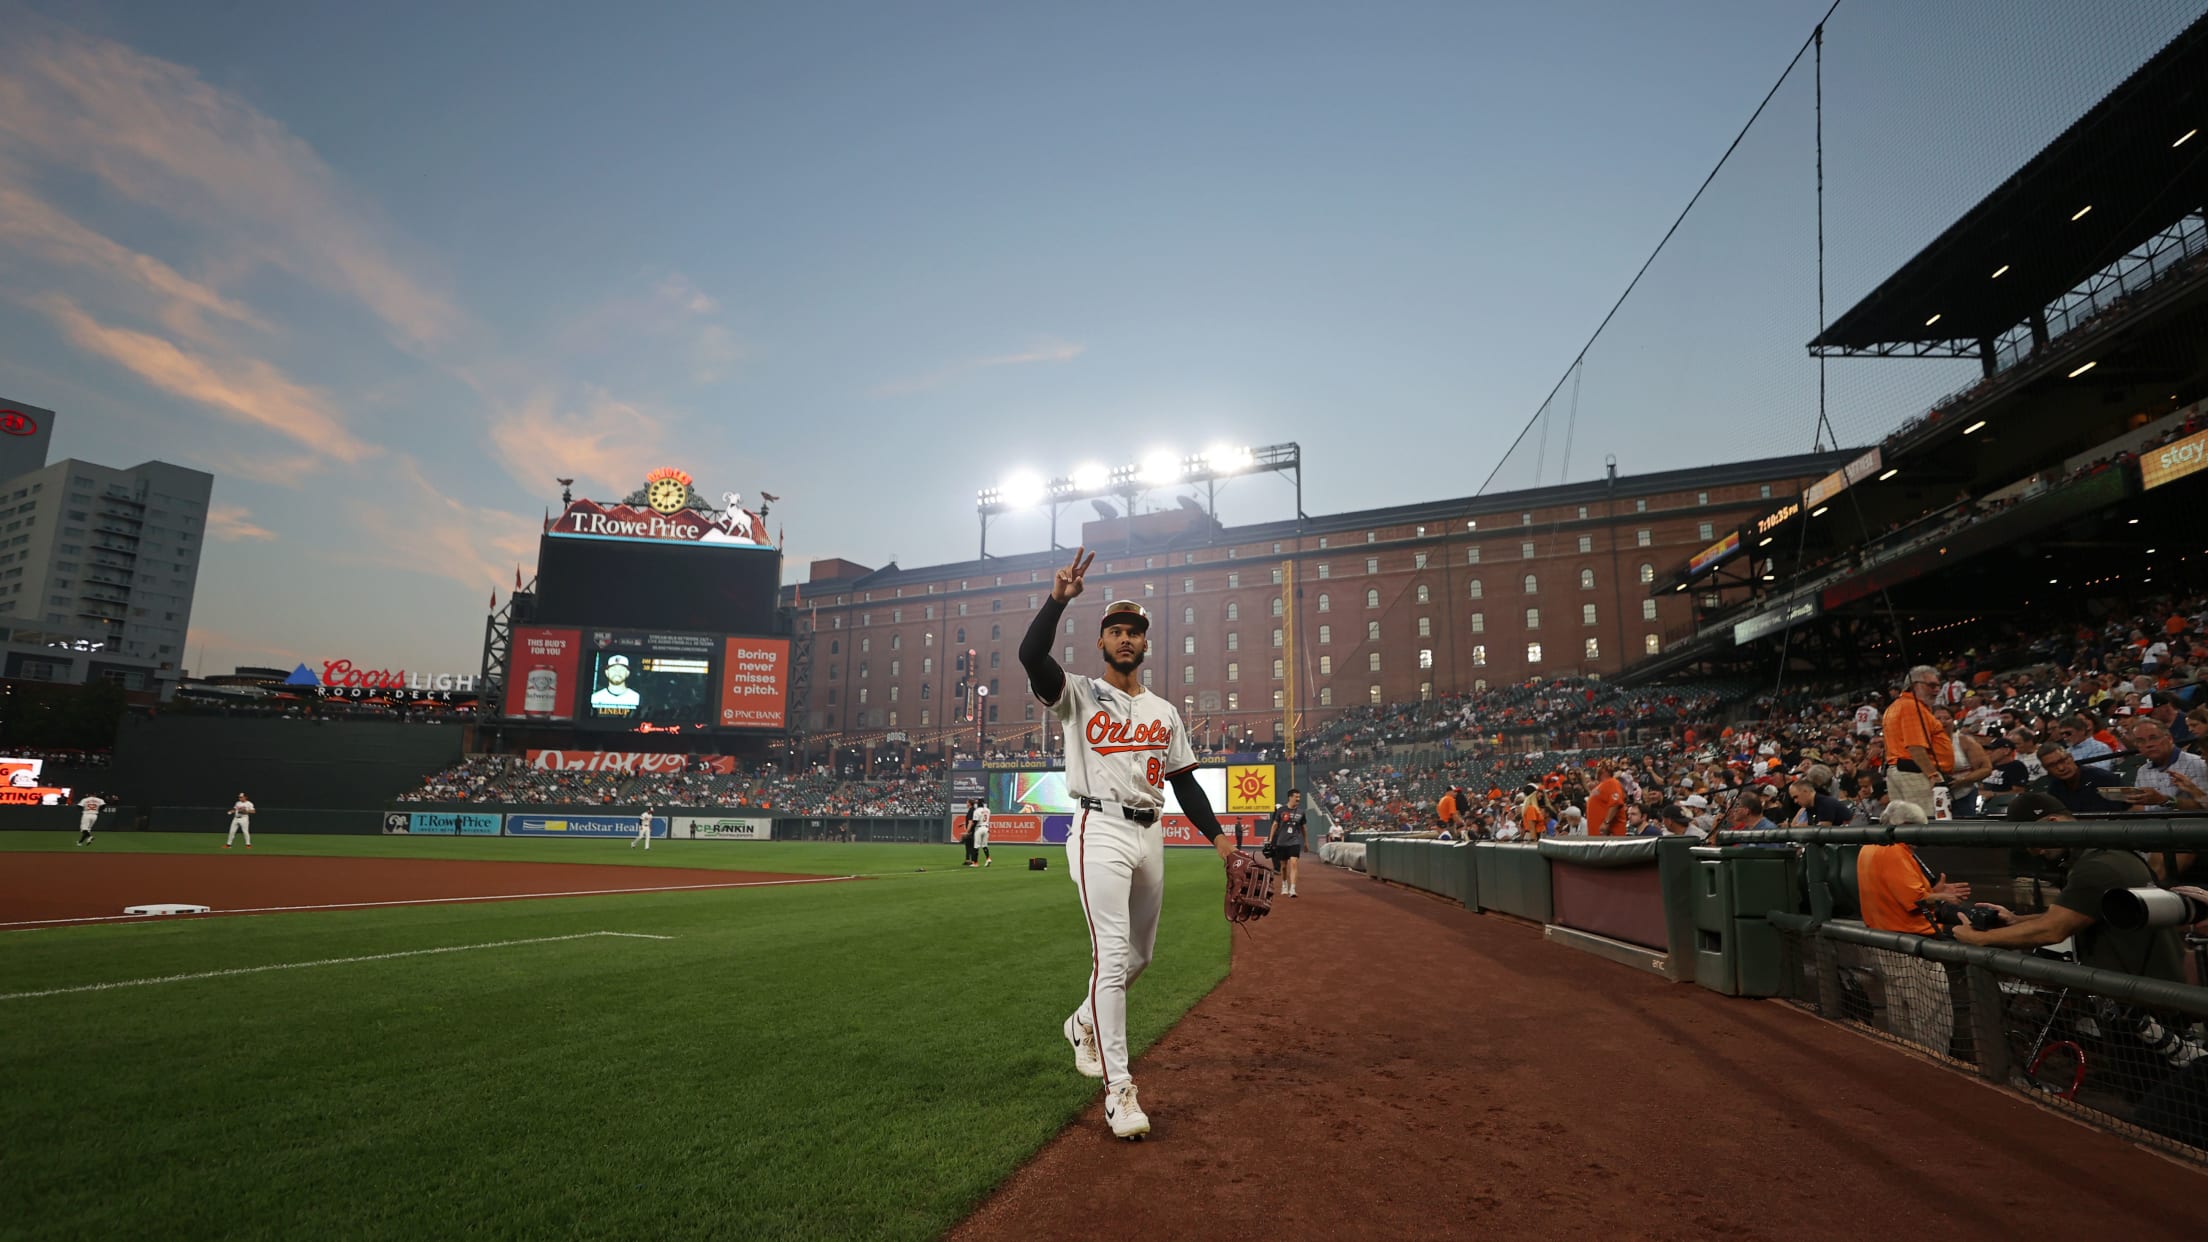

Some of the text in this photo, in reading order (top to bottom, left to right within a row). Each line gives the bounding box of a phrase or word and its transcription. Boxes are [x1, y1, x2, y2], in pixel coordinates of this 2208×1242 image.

[2161, 439, 2206, 469] stay
[1757, 506, 1789, 534] 7:10:35
[651, 517, 699, 540] Price
[527, 638, 544, 647] THIS
[530, 647, 561, 656] FOR YOU
[737, 649, 777, 662] Boring
[739, 662, 774, 671] never
[322, 659, 482, 692] Coors LIGH
[735, 671, 776, 683] misses
[317, 686, 451, 700] ROOF DECK
[733, 684, 779, 697] a pitch.
[735, 710, 782, 720] PNC BANK
[1086, 710, 1172, 744] Orioles
[981, 759, 1019, 769] Personal
[1020, 759, 1047, 768] Loans
[1199, 754, 1227, 764] oans
[462, 815, 492, 827] Price
[569, 821, 640, 832] MedStar Heal
[989, 821, 1035, 829] TUMN LAKE
[1162, 826, 1191, 840] IGH'S
